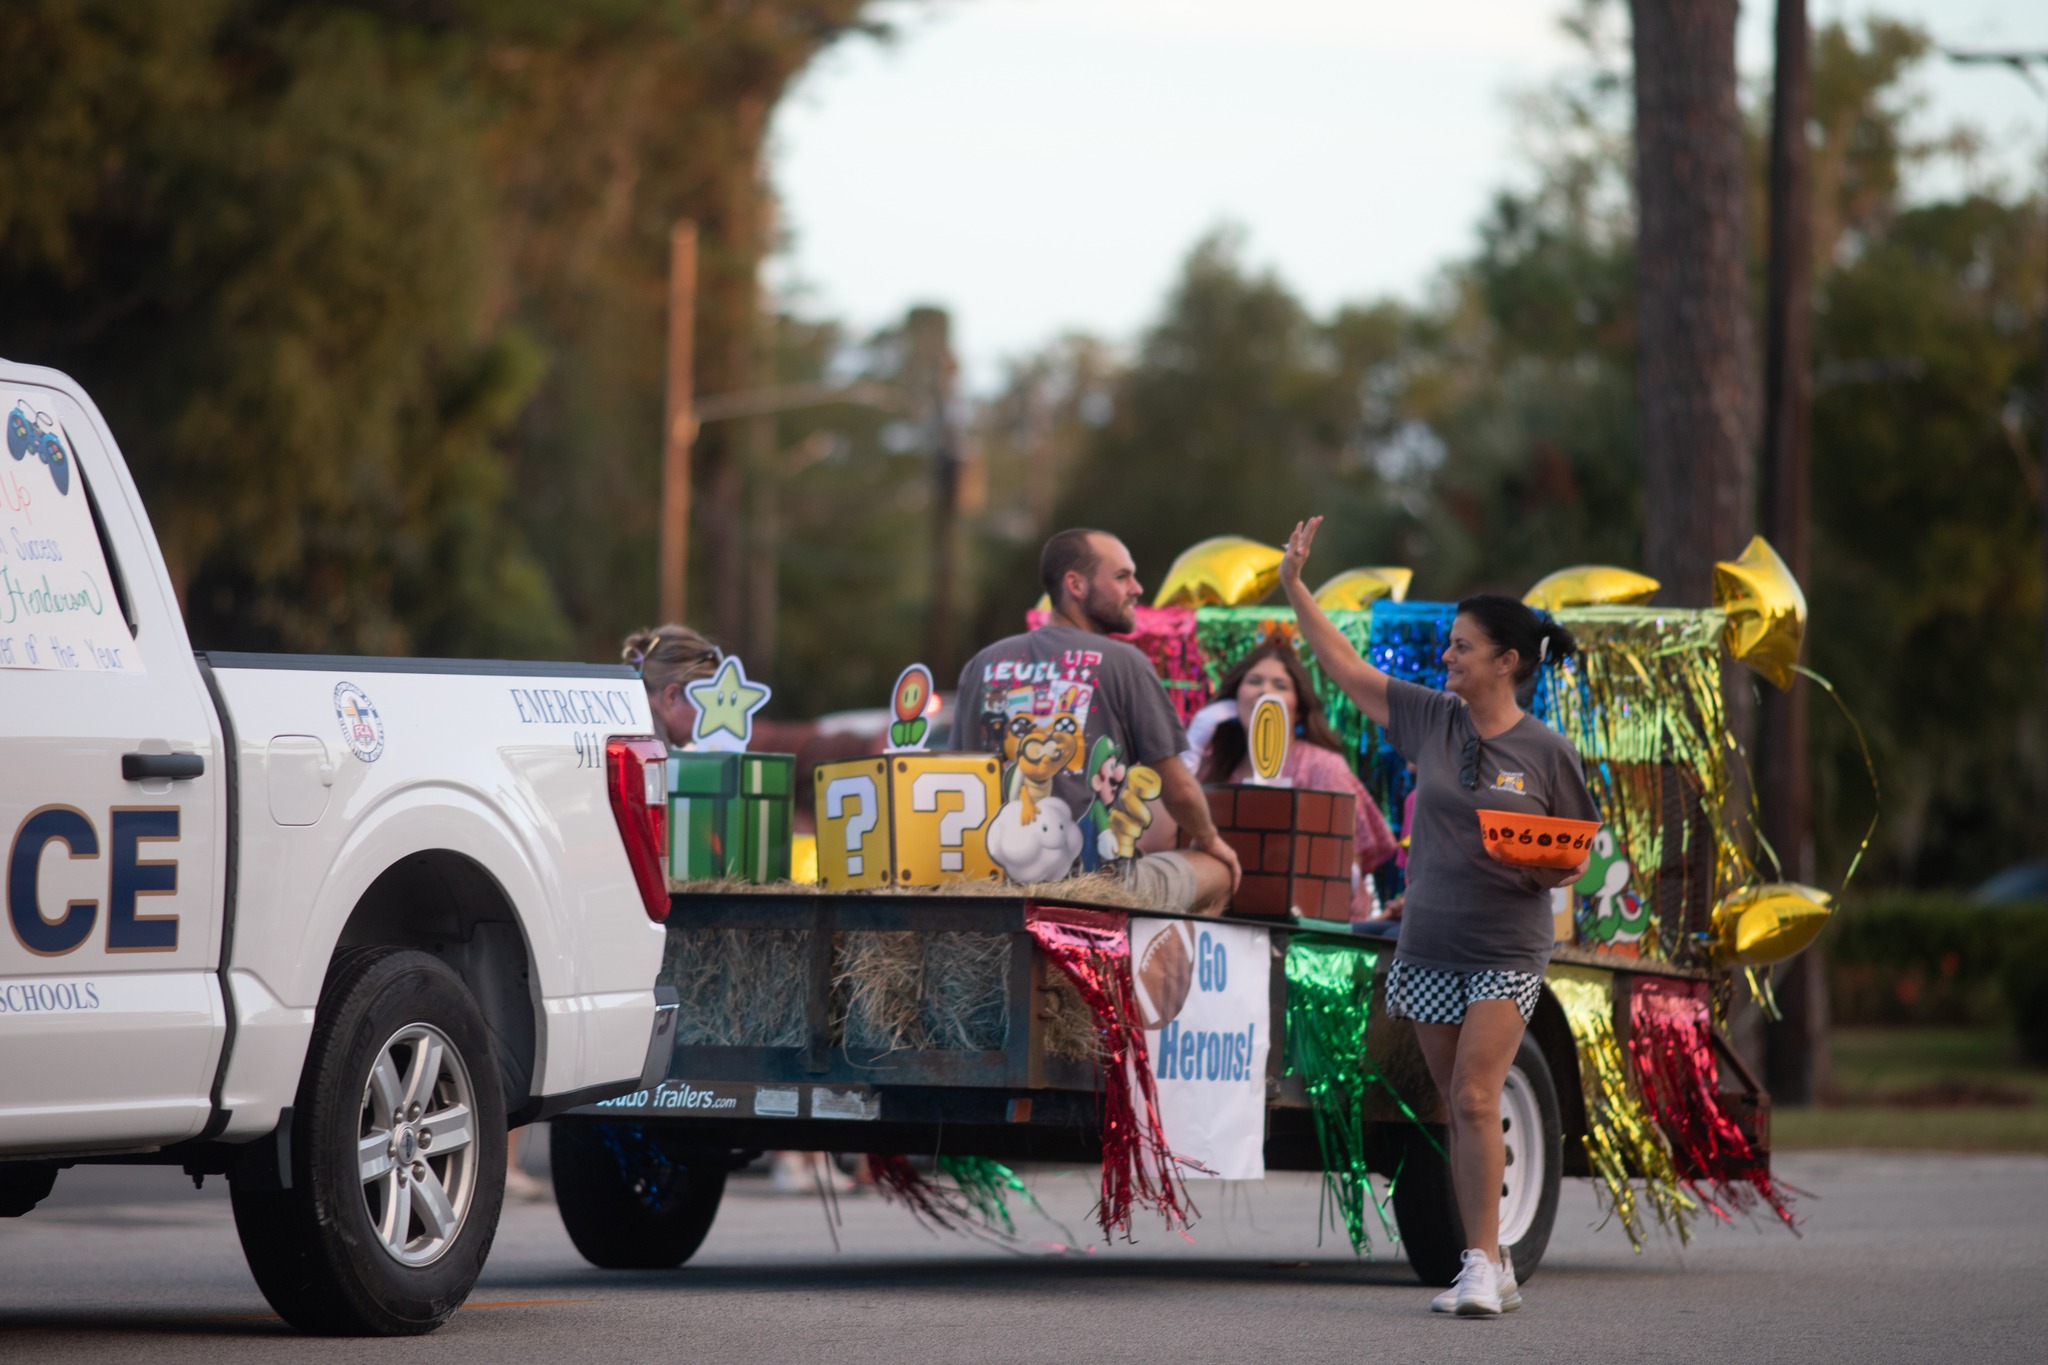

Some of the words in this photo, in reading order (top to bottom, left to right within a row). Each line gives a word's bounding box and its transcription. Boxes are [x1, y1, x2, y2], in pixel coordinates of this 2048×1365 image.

[0, 470, 33, 526] Up
[49, 635, 80, 669] the
[83, 638, 125, 670] Year
[508, 688, 638, 725] EMERGENCY
[573, 731, 603, 769] 911
[1198, 930, 1227, 992] Go
[1156, 1020, 1255, 1082] Herons!
